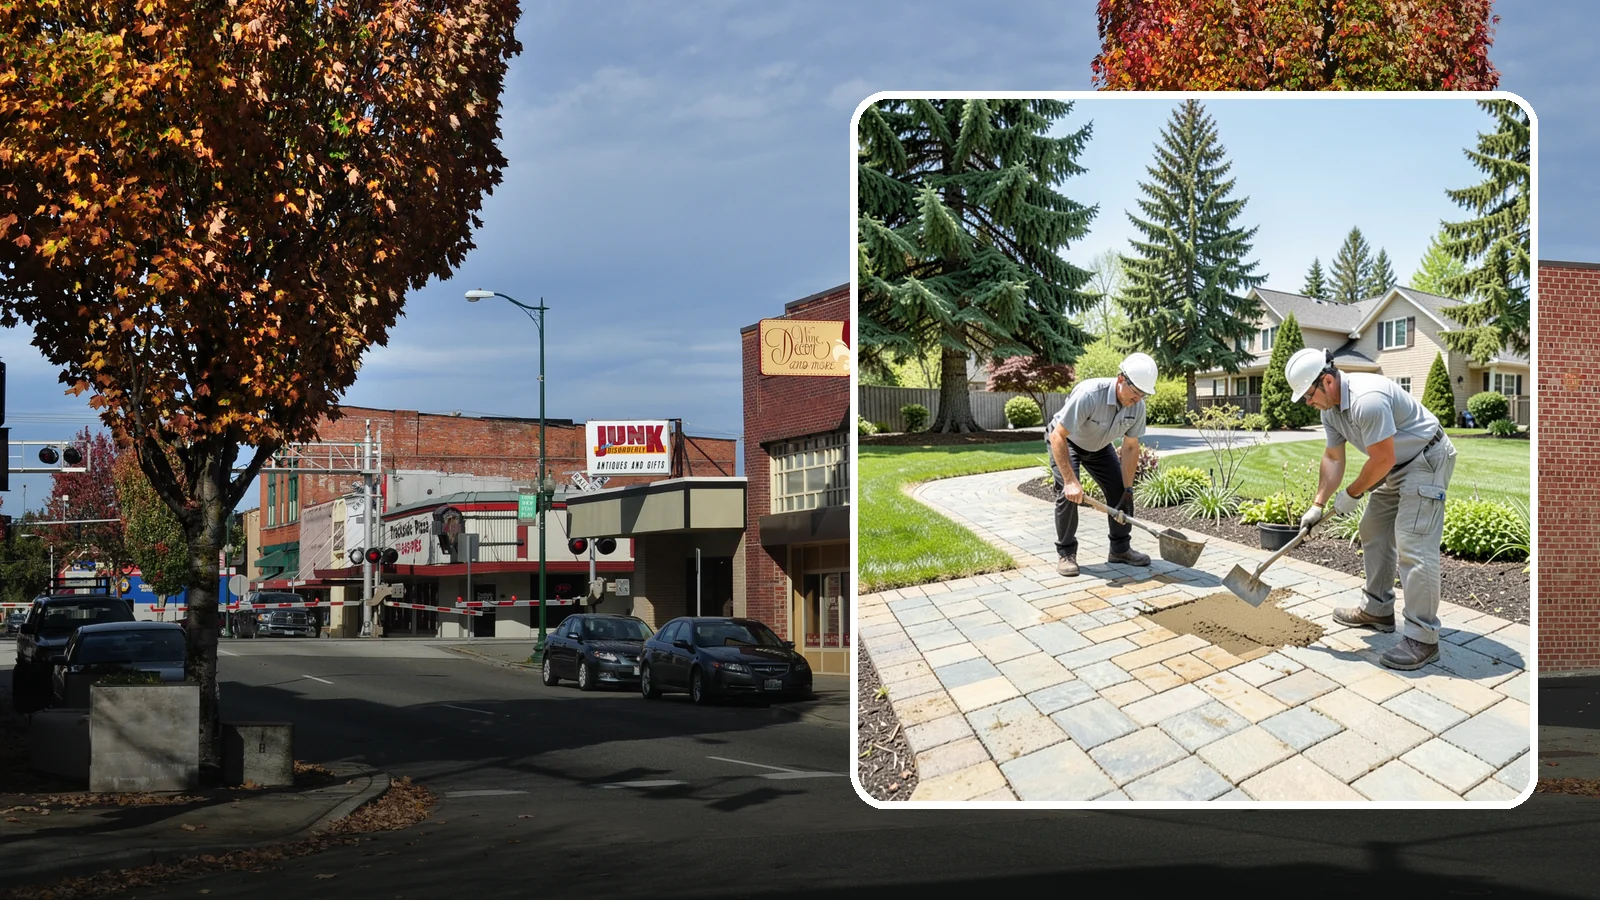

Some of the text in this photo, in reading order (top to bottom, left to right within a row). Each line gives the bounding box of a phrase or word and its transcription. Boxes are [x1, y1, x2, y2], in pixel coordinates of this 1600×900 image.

[595, 425, 665, 457] JUNK
[607, 446, 646, 454] DISORDERLY
[597, 460, 665, 470] ANTIQUES AND GIFTS
[352, 498, 365, 511] CRO
[414, 519, 429, 535] Pizza
